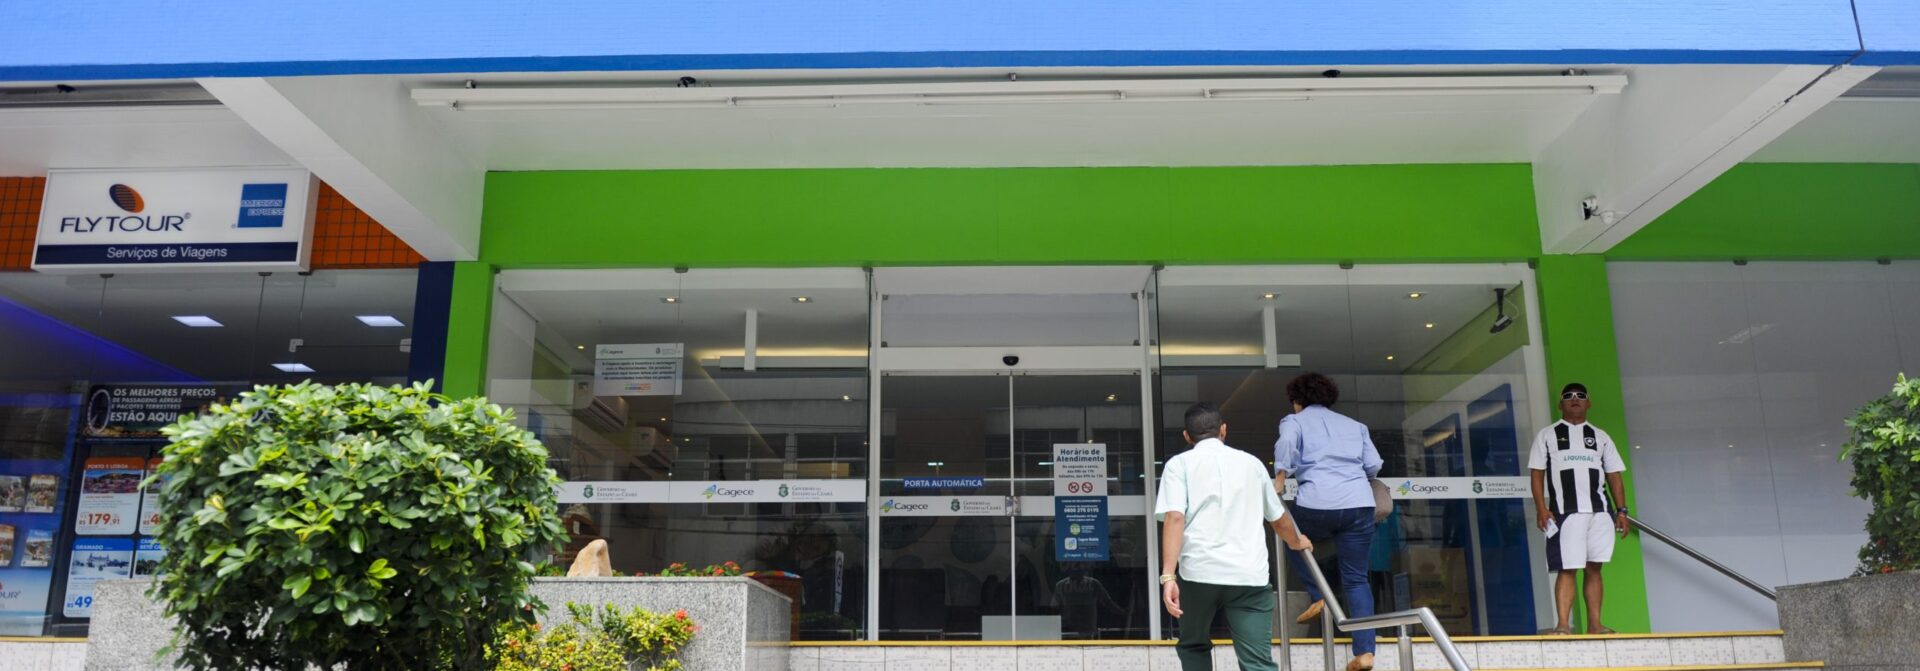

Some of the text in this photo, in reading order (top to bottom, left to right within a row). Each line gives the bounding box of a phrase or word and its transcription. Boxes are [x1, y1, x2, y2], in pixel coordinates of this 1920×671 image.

[107, 247, 227, 260] Serviços de Viagens
[113, 388, 127, 397] OS
[129, 388, 178, 397] MELHORES
[110, 409, 177, 423] ESTÃO AQUI
[1060, 447, 1089, 455] Horário
[931, 479, 983, 487] AUTOMÁTICA
[717, 487, 754, 497] Cagece
[1411, 483, 1449, 494] Cagece
[894, 502, 928, 511] Cagece
